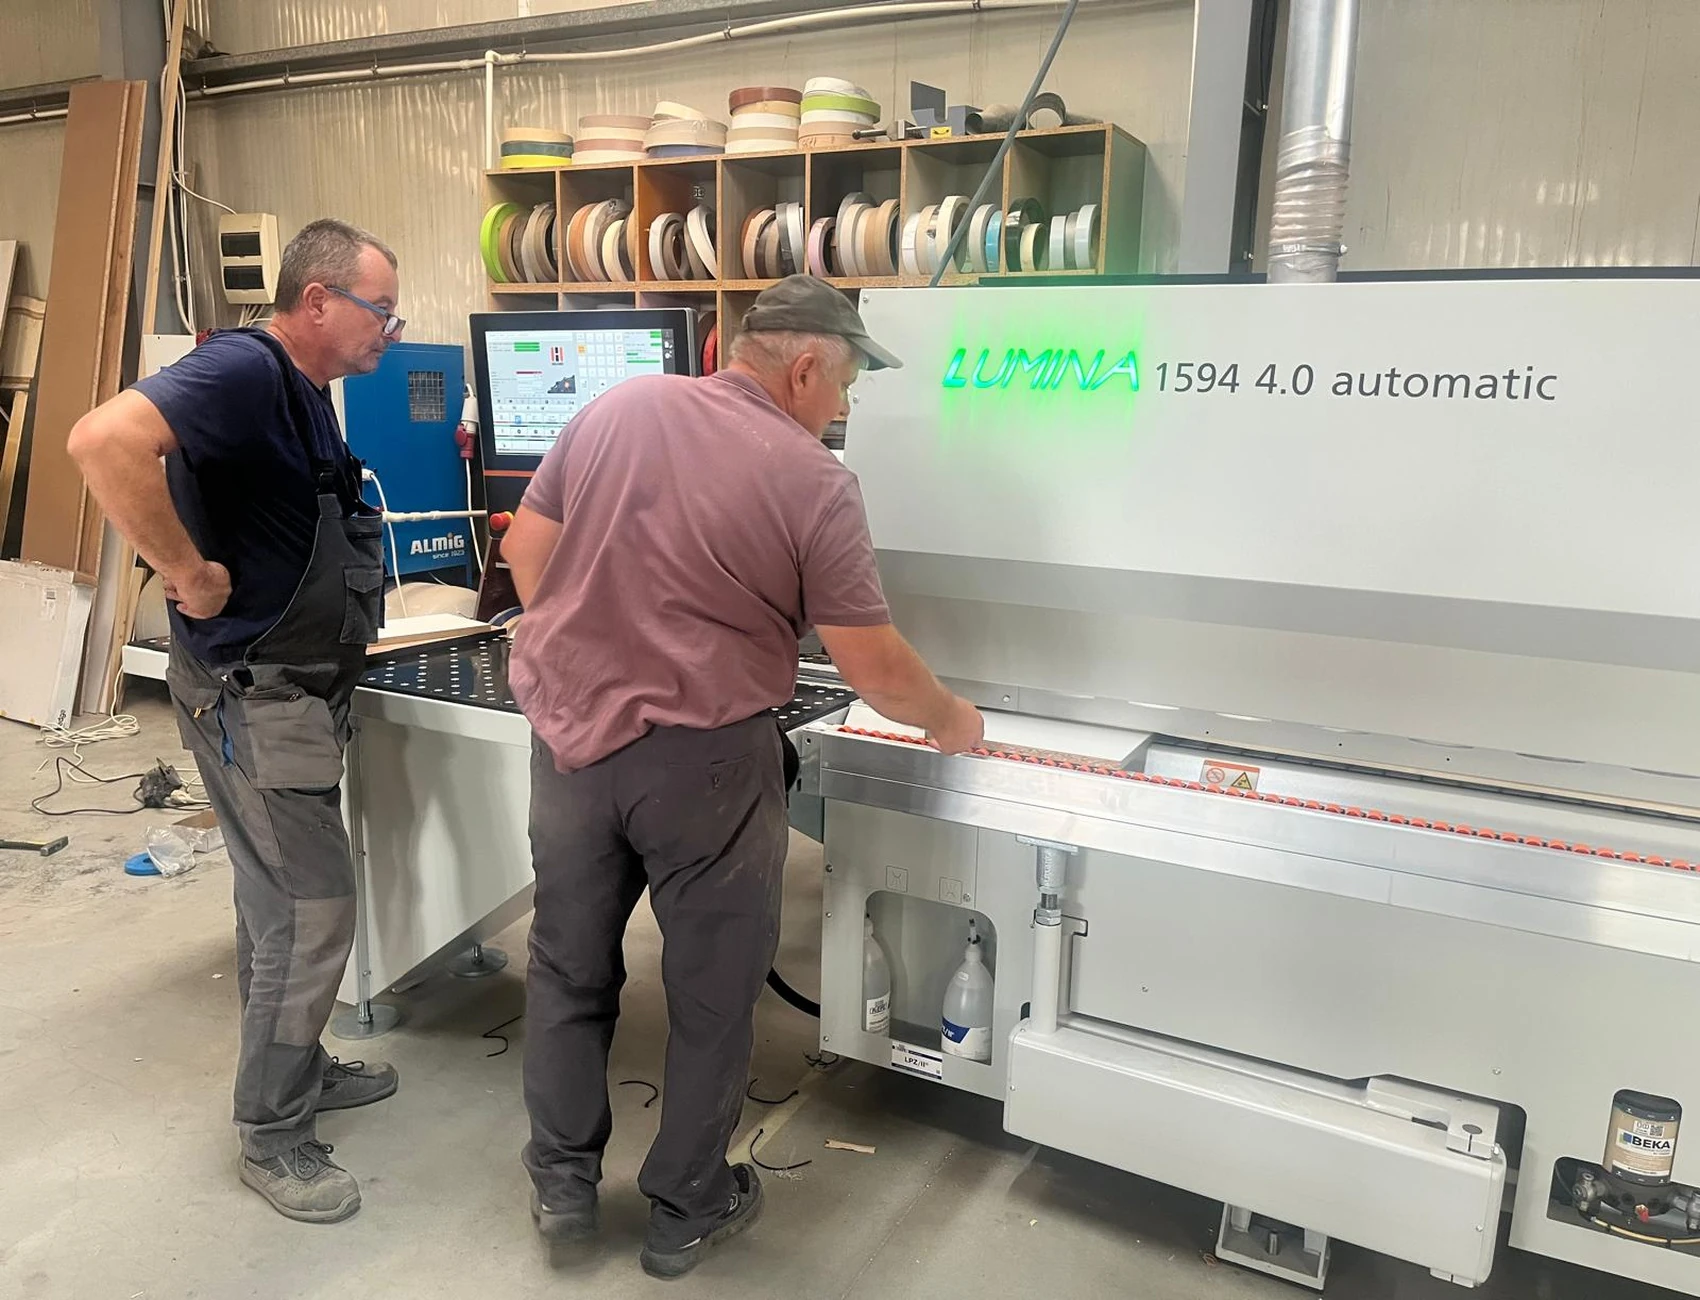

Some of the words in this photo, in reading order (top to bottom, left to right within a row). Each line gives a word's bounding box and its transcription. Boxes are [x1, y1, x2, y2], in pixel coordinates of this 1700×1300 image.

[942, 348, 1140, 392] LUMINA
[1156, 362, 1240, 394] 1594
[1255, 363, 1315, 396] 4.0
[1331, 365, 1558, 400] automatic
[1632, 1135, 1670, 1149] BEKA
